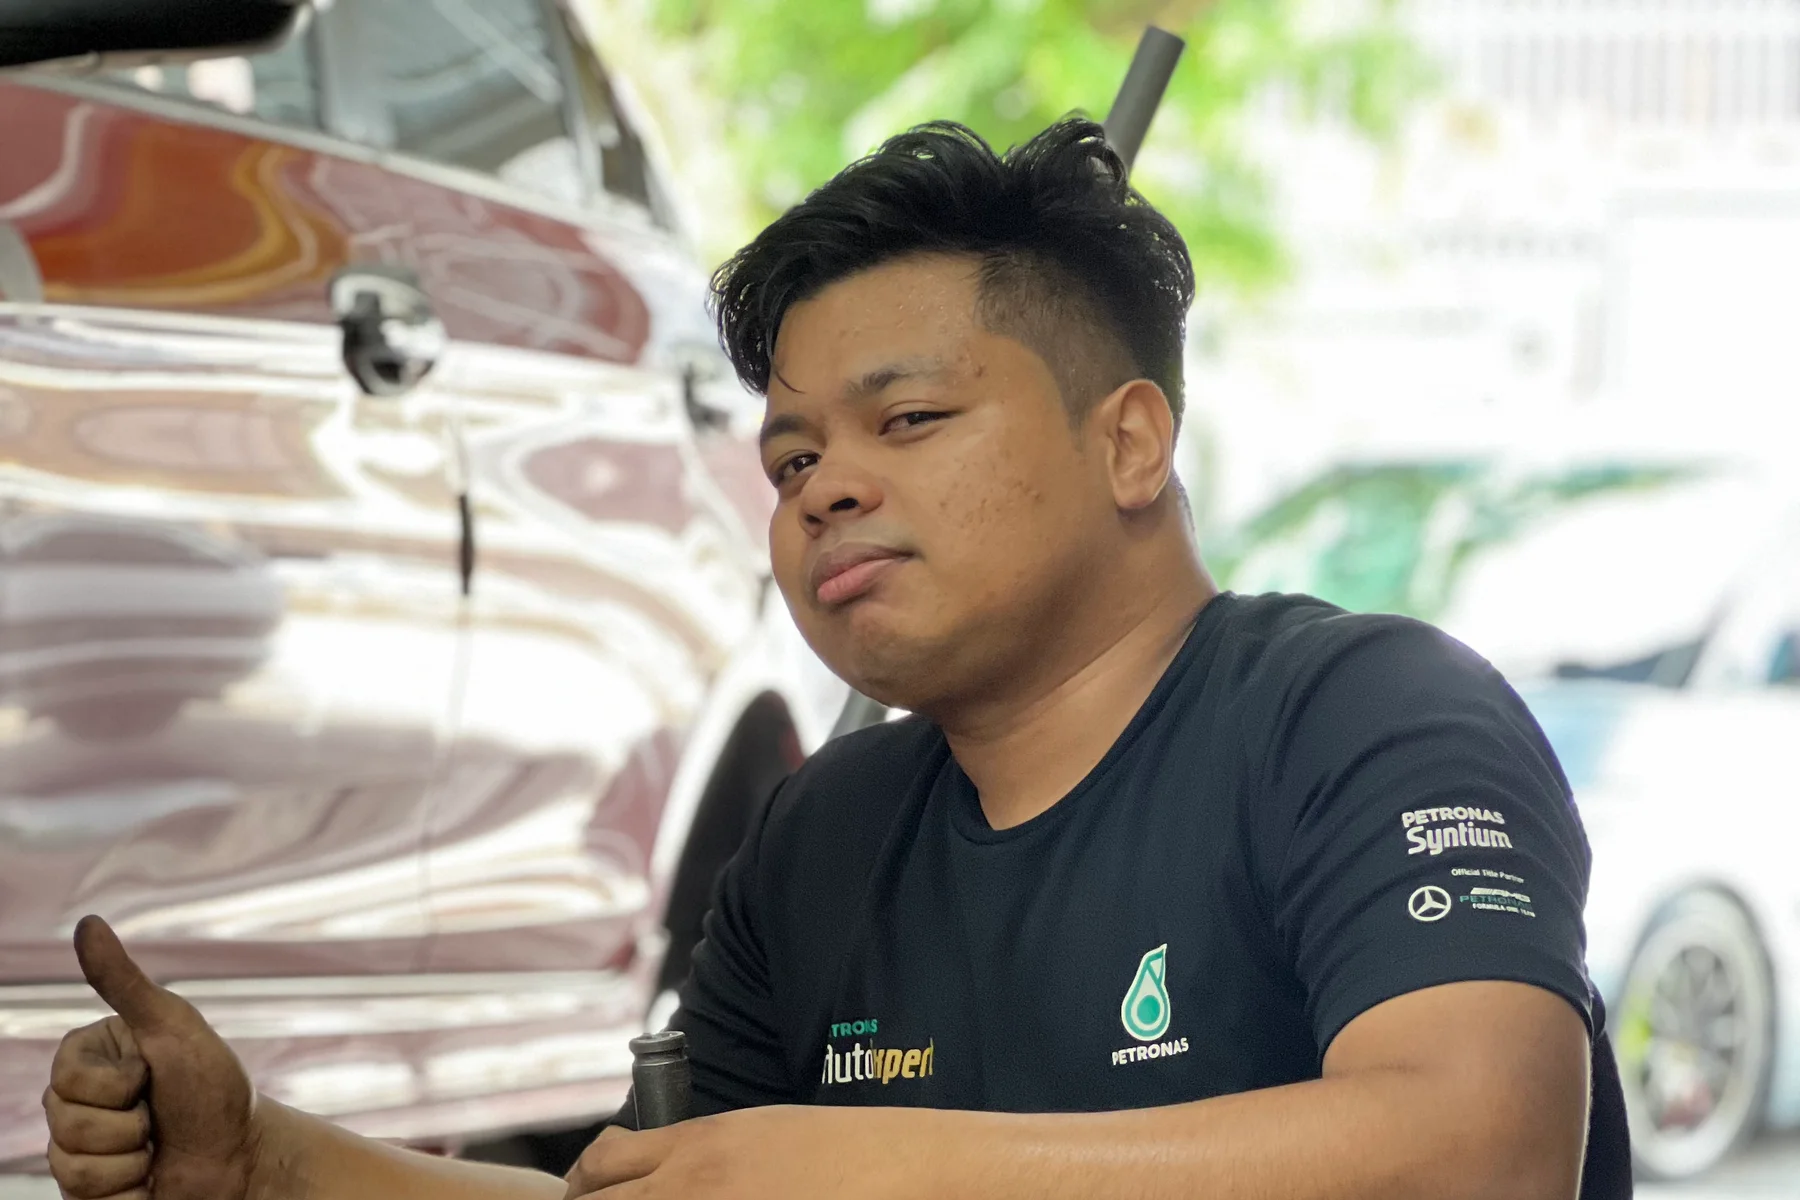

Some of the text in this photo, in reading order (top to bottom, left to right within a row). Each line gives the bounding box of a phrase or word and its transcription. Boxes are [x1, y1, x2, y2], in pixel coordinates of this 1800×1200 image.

[1401, 806, 1506, 828] PETRONAS
[1406, 821, 1514, 856] Syntium
[1451, 868, 1481, 877] Official
[1111, 1037, 1190, 1066] PETRONAS
